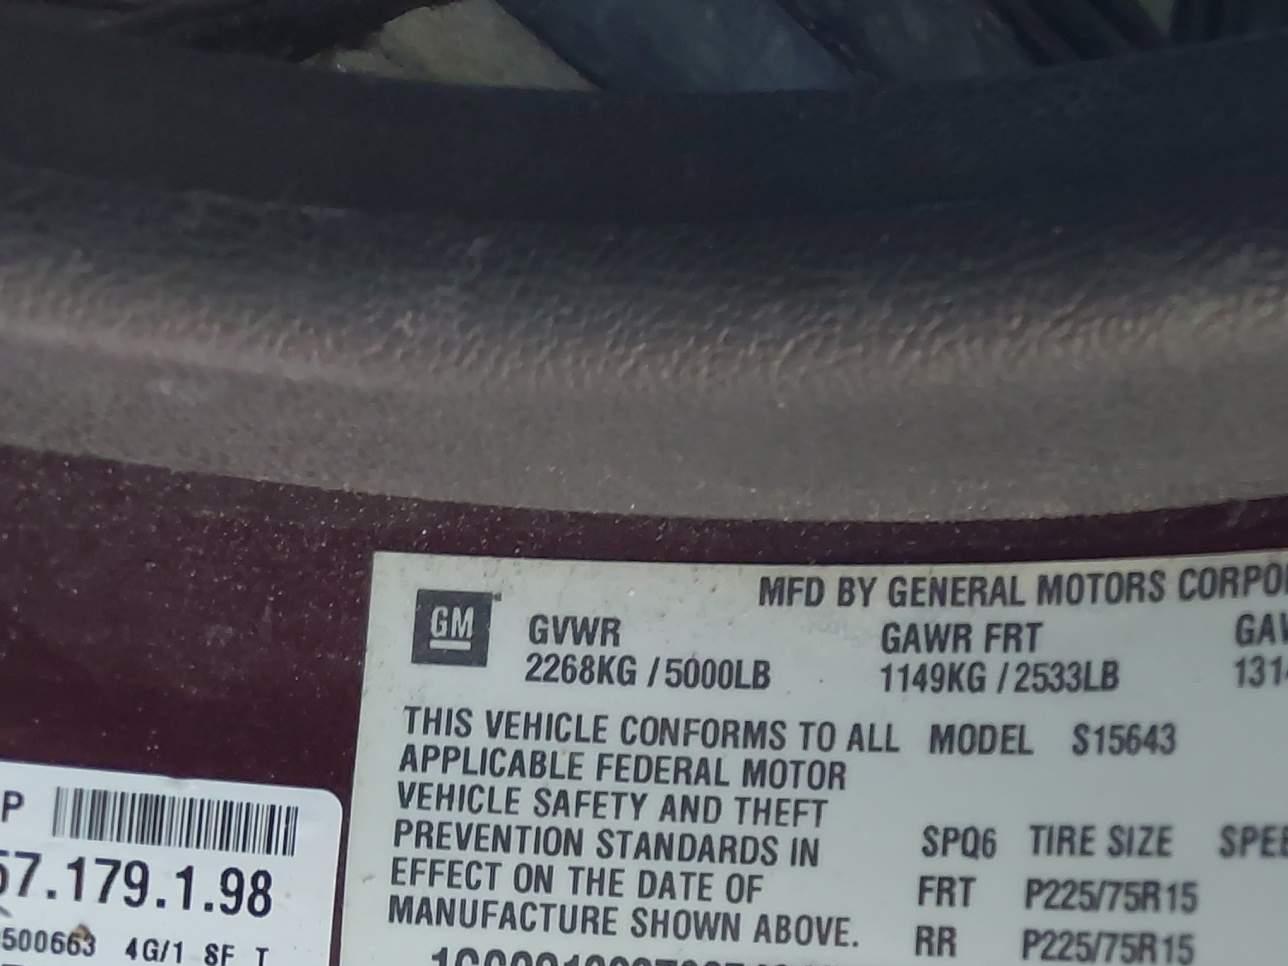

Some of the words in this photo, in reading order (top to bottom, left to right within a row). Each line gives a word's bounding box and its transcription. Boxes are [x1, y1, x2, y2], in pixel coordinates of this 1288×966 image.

[758, 576, 824, 607] MFD
[837, 576, 877, 607] BY
[888, 575, 1025, 607] GENERAL
[1037, 571, 1165, 605] MOTORS
[430, 605, 474, 639] GM
[529, 614, 621, 647] GVWR
[881, 623, 972, 653] GAWR
[985, 622, 1044, 653] FRT
[525, 653, 636, 687] 2268KG
[880, 662, 986, 693] 1149KG
[404, 706, 473, 738] THIS
[486, 710, 608, 744] VEHICLE
[621, 715, 786, 750] CONFORMS
[800, 722, 835, 752] TO
[847, 723, 900, 753] ALL
[930, 723, 1033, 755] MODEL
[1072, 722, 1176, 756] S15643
[399, 744, 583, 780] APPLICABLE
[597, 753, 730, 787] FEDERAL
[743, 759, 847, 790] MOTOR
[397, 781, 520, 816] VEHICLE
[533, 788, 648, 823] SAFETY
[659, 793, 721, 825] AND
[738, 796, 828, 828] THEFT
[394, 819, 583, 857] PREVENTION
[596, 828, 778, 867] STANDARDS
[790, 837, 819, 867] IN
[922, 824, 997, 858] SPQ6
[1030, 824, 1095, 857] TIRE
[1107, 825, 1173, 857] SIZE
[391, 858, 502, 892] EFFECT
[514, 863, 553, 894] ON
[568, 865, 624, 897] THE
[638, 869, 714, 901] DATE
[726, 873, 764, 904] OF
[917, 875, 976, 907] FRT
[1025, 878, 1198, 914] P225/75R15
[388, 896, 618, 937] MANUFACTURE
[631, 908, 740, 943] SHOWN
[754, 915, 859, 948] ABOVE.
[125, 938, 183, 964] 4G/1
[915, 926, 957, 957] RR
[1022, 929, 1194, 966] P225/75R15
